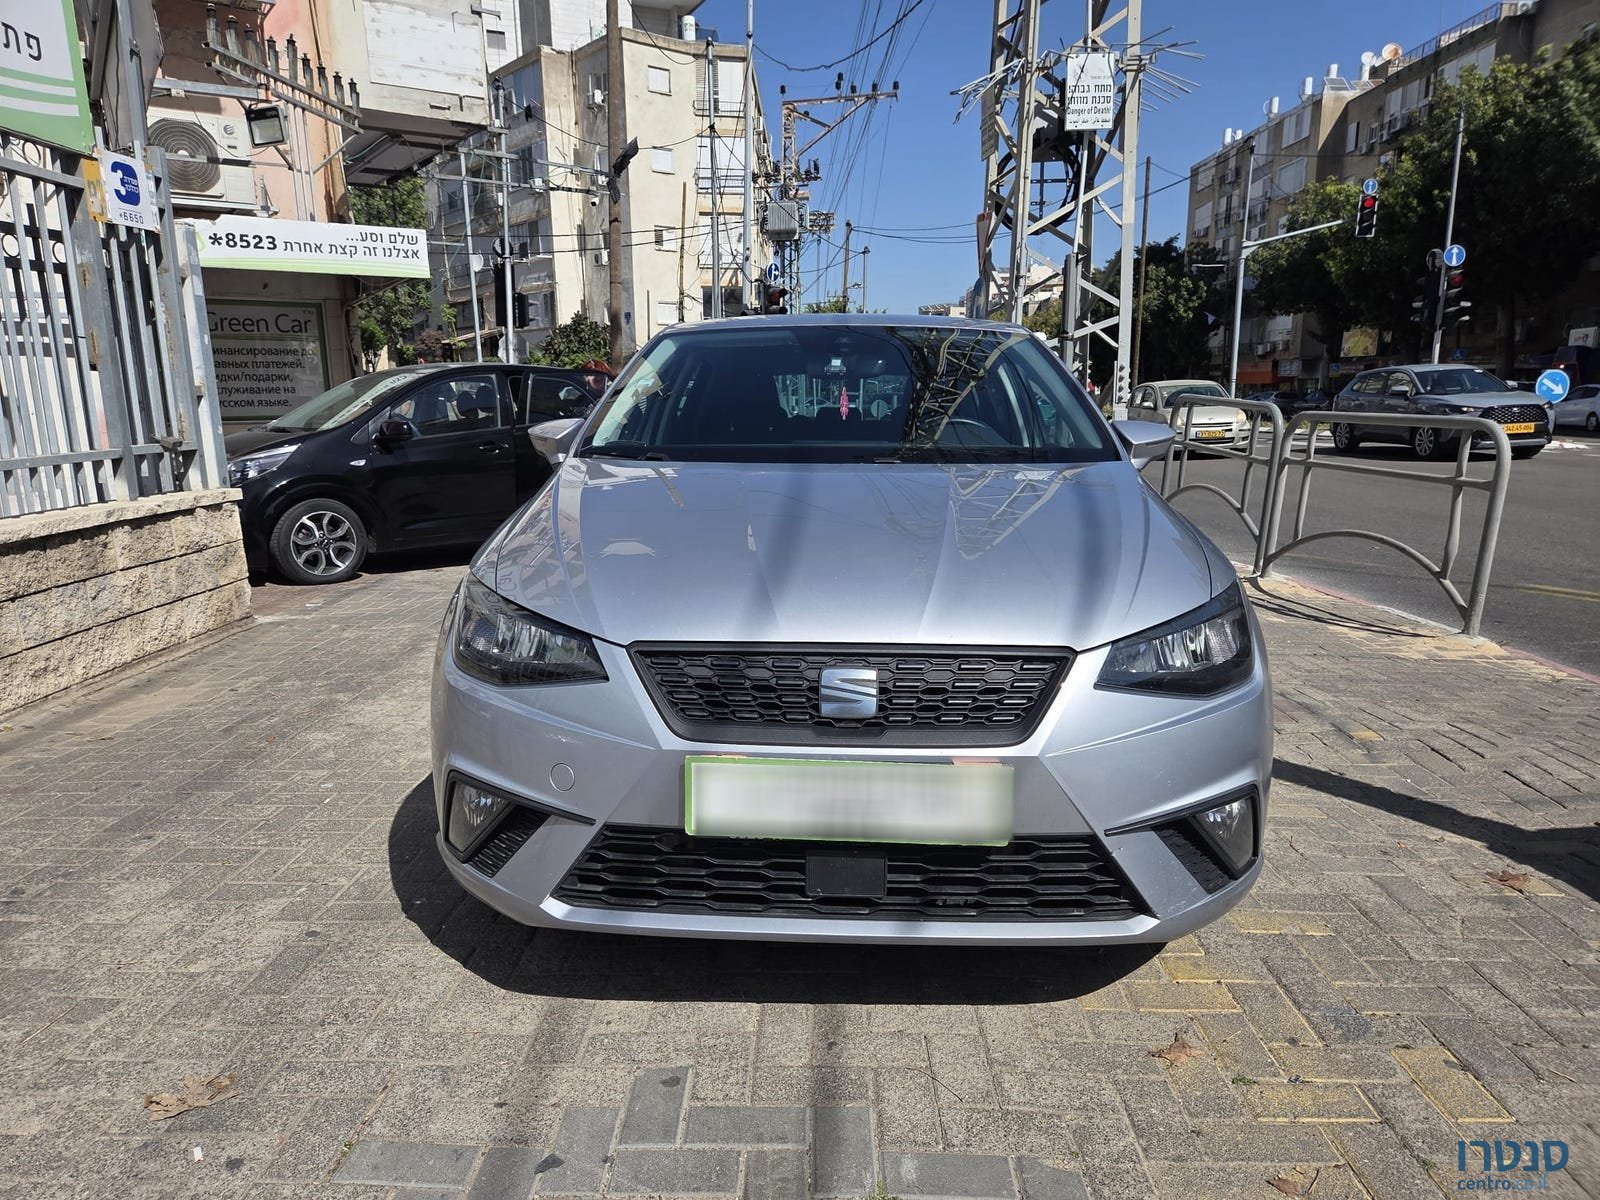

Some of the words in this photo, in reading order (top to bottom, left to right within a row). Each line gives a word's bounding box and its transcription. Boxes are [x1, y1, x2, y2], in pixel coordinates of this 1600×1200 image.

[1094, 84, 1112, 93] מתח
[1091, 95, 1112, 104] סכנת
[1067, 106, 1086, 116] Danger
[1088, 106, 1094, 114] of
[1094, 106, 1111, 114] Death!
[346, 231, 383, 243] וסע...
[388, 231, 418, 246] שלם
[283, 240, 324, 254] אחרת
[328, 243, 358, 258] קצת
[363, 246, 378, 257] זה
[382, 245, 420, 260] אצלנו
[207, 311, 269, 332] Green
[275, 313, 312, 333] Car
[212, 347, 298, 357] инансирование
[251, 358, 306, 369] платежей.
[284, 386, 296, 395] на
[257, 398, 292, 407] языке.
